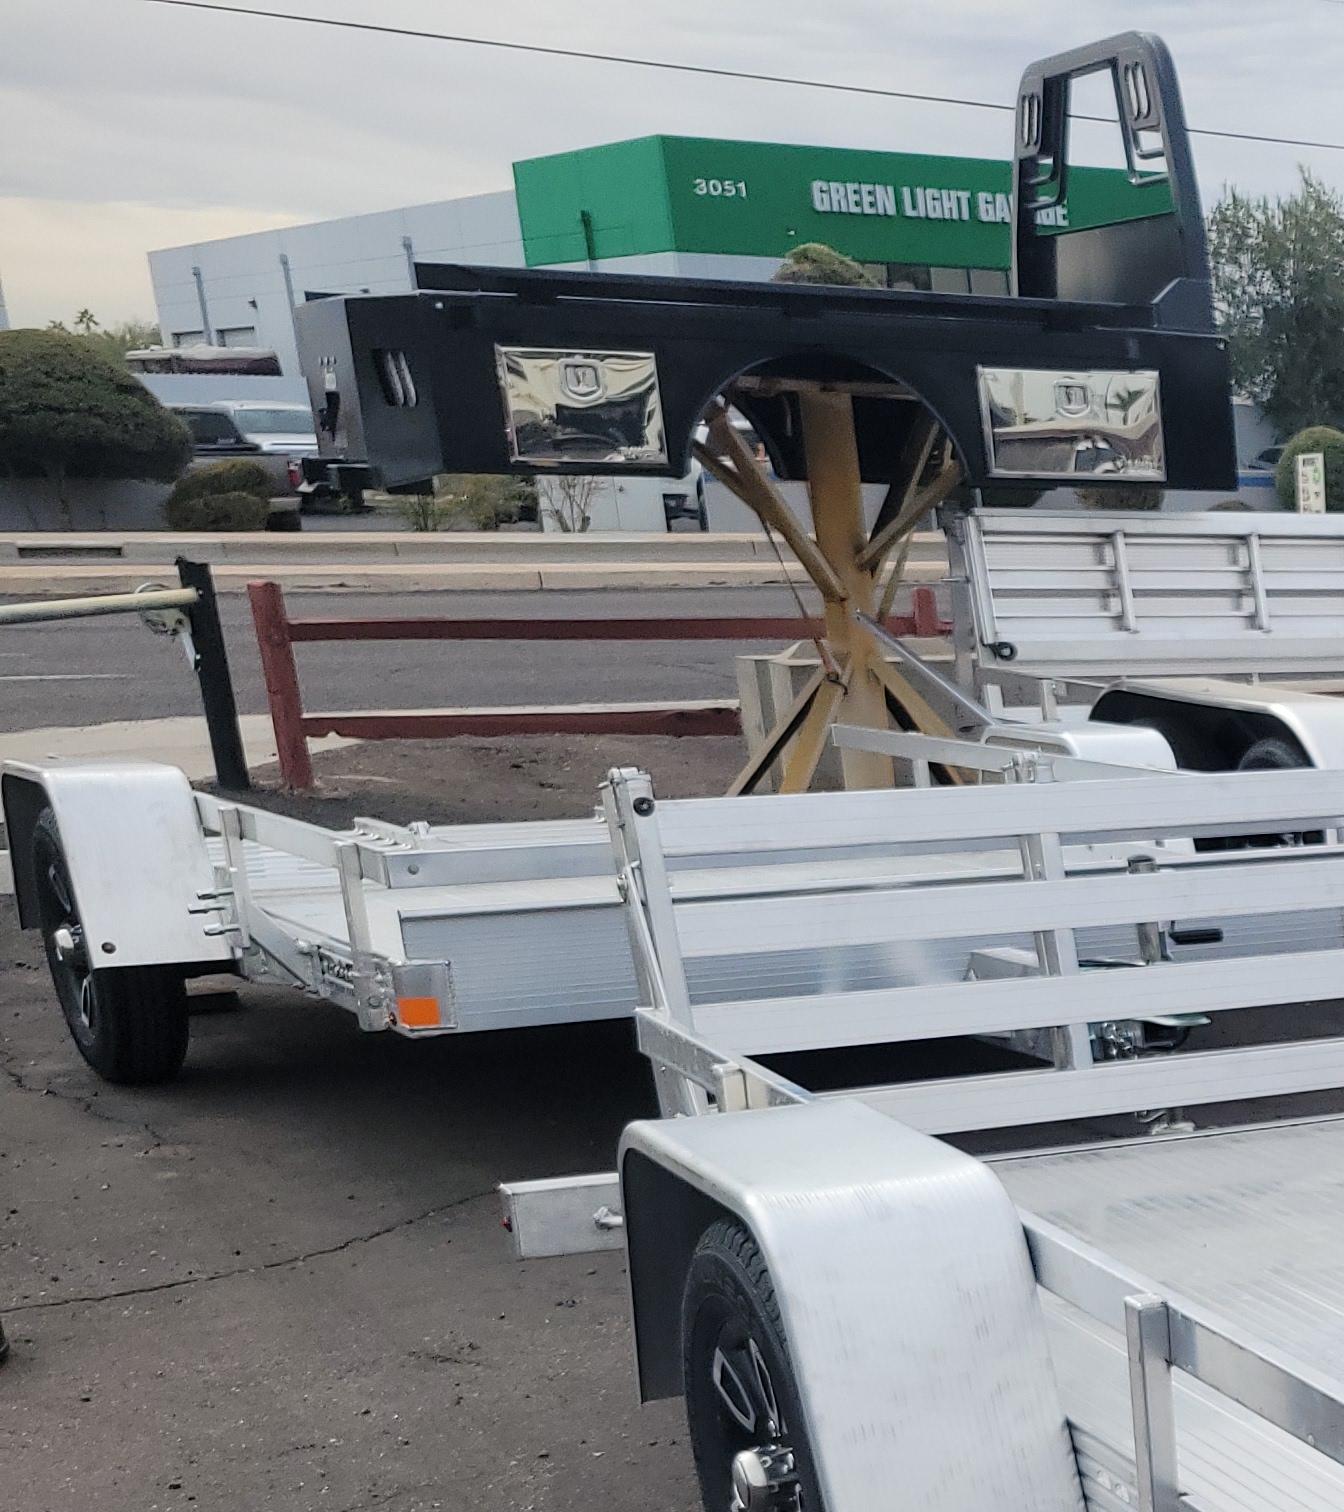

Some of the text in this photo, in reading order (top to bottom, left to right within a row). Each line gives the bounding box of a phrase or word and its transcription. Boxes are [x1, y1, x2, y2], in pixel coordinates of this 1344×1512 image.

[692, 178, 747, 200] 3051
[811, 180, 1069, 227] GREEN LIGHT GAGE
